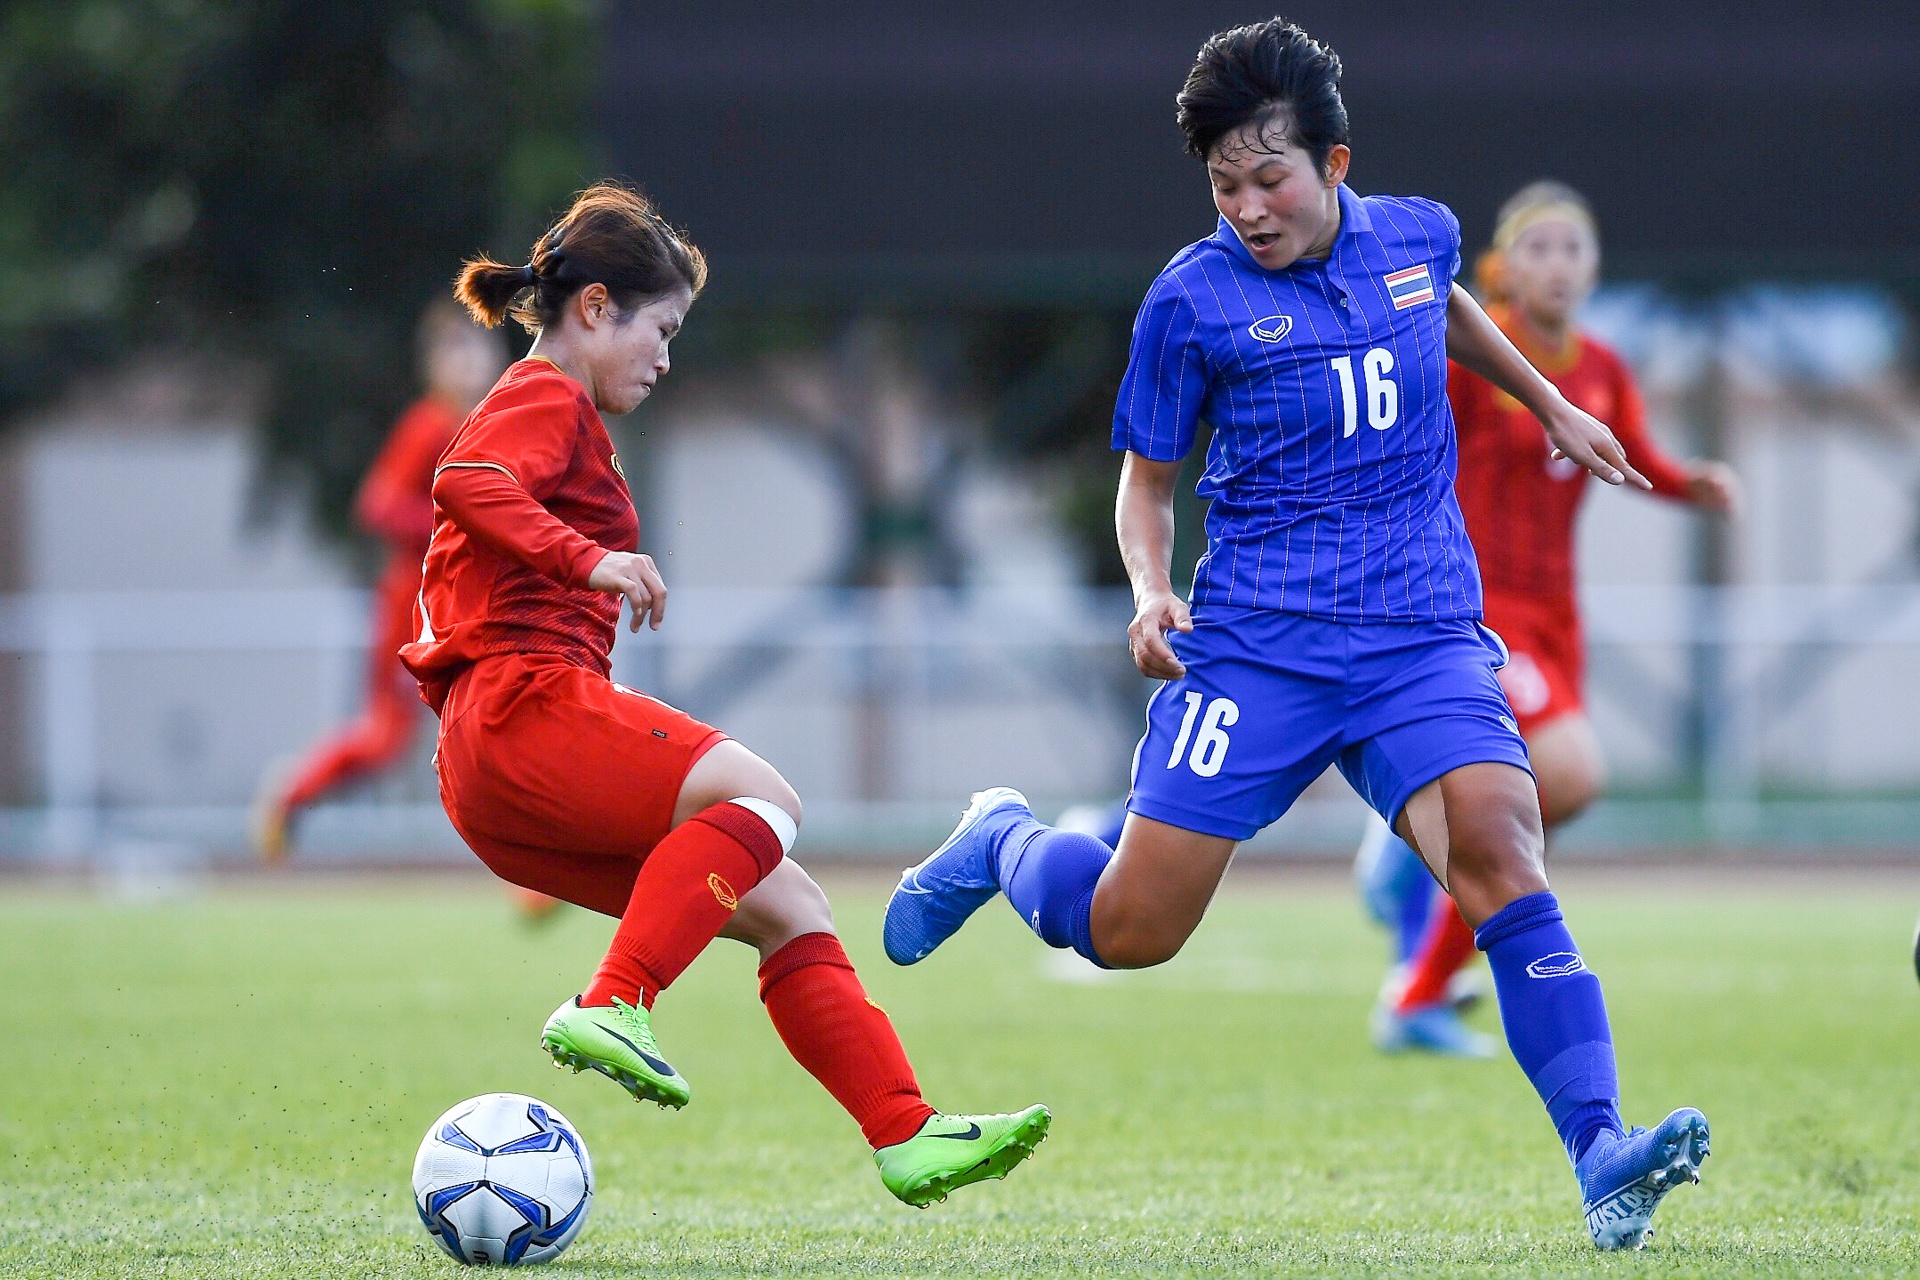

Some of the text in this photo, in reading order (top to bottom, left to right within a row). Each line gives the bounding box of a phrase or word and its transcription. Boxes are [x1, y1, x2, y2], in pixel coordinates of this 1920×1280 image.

[1330, 347, 1398, 439] 16
[1166, 690, 1240, 778] 16
[1589, 1198, 1629, 1237] JUST
[1620, 1185, 1654, 1210] DO
